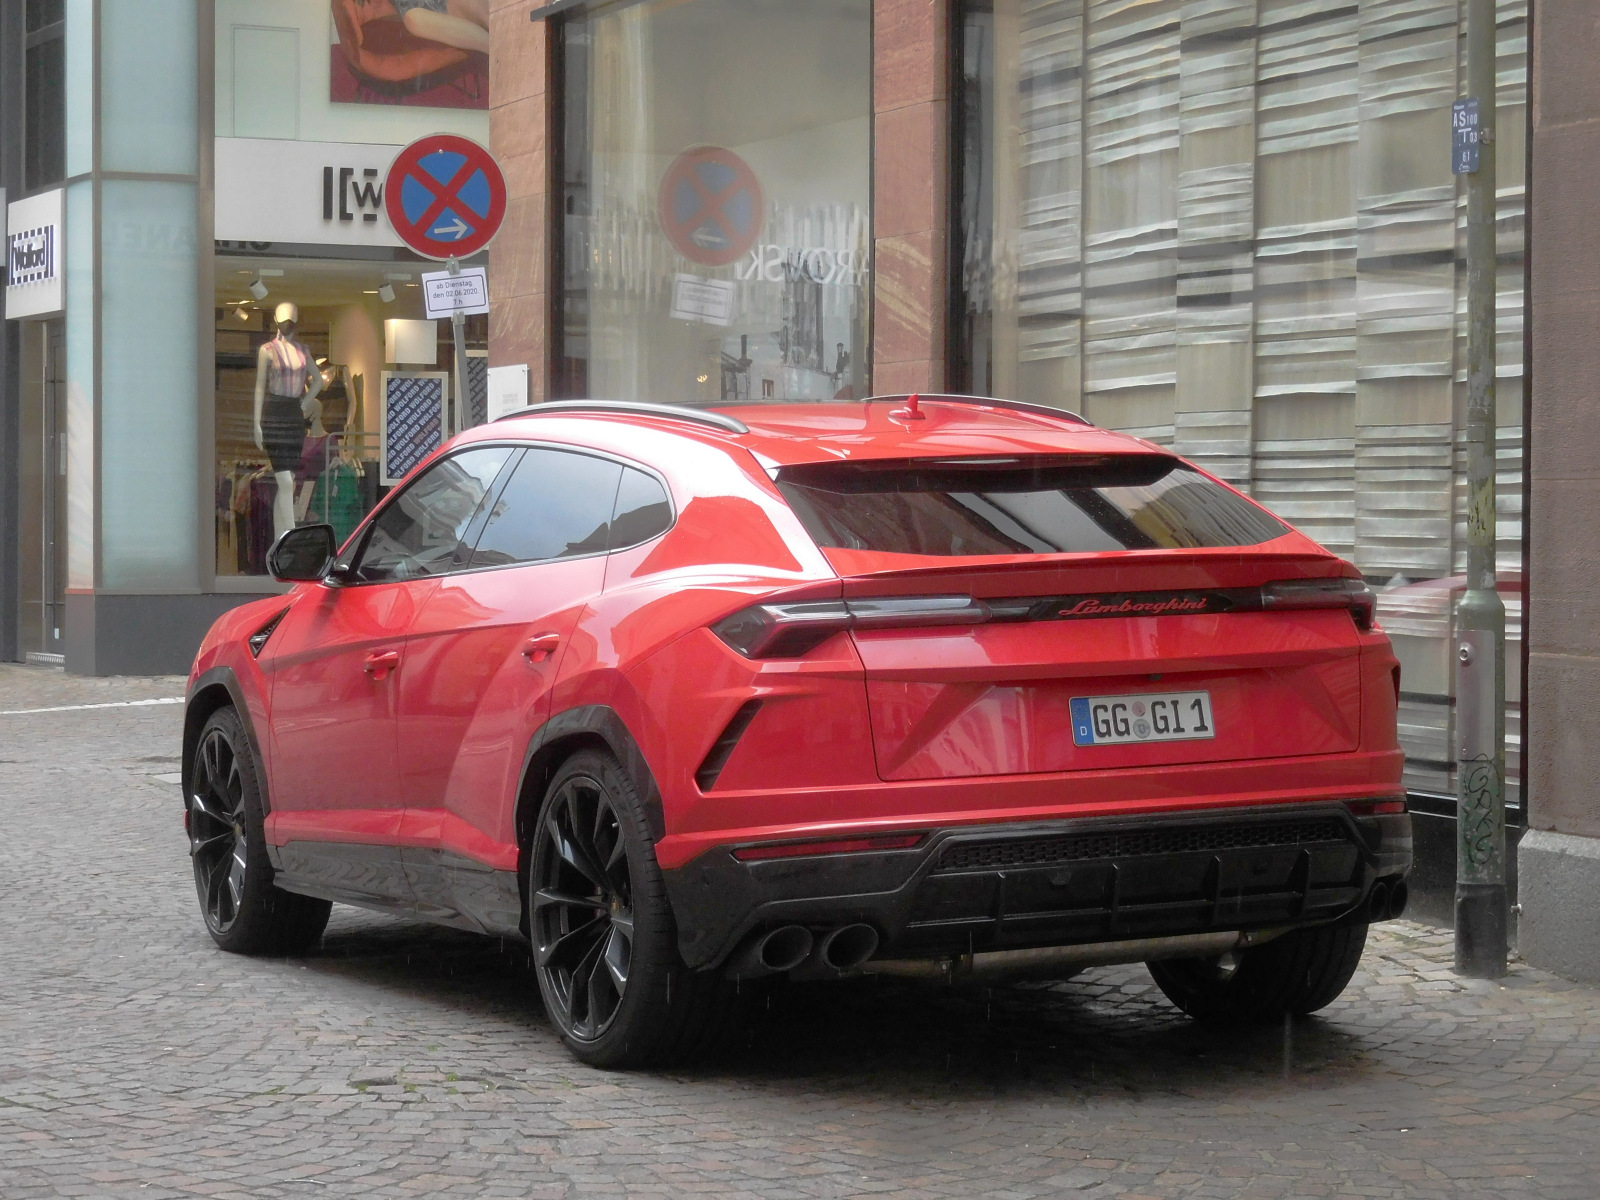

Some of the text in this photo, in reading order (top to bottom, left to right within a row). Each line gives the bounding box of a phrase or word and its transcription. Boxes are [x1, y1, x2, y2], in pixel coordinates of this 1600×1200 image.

[394, 385, 420, 411] WOLFORD
[409, 383, 434, 409] WOLFORD
[407, 399, 432, 425] WOLFORD
[389, 443, 415, 470] WOLFORD
[413, 418, 439, 444] WOLFORD
[395, 424, 420, 450] WOLFORD
[414, 431, 439, 457] WOLFORD
[1058, 597, 1207, 616] Lamborghini
[1080, 698, 1208, 738] D GG GI 1
